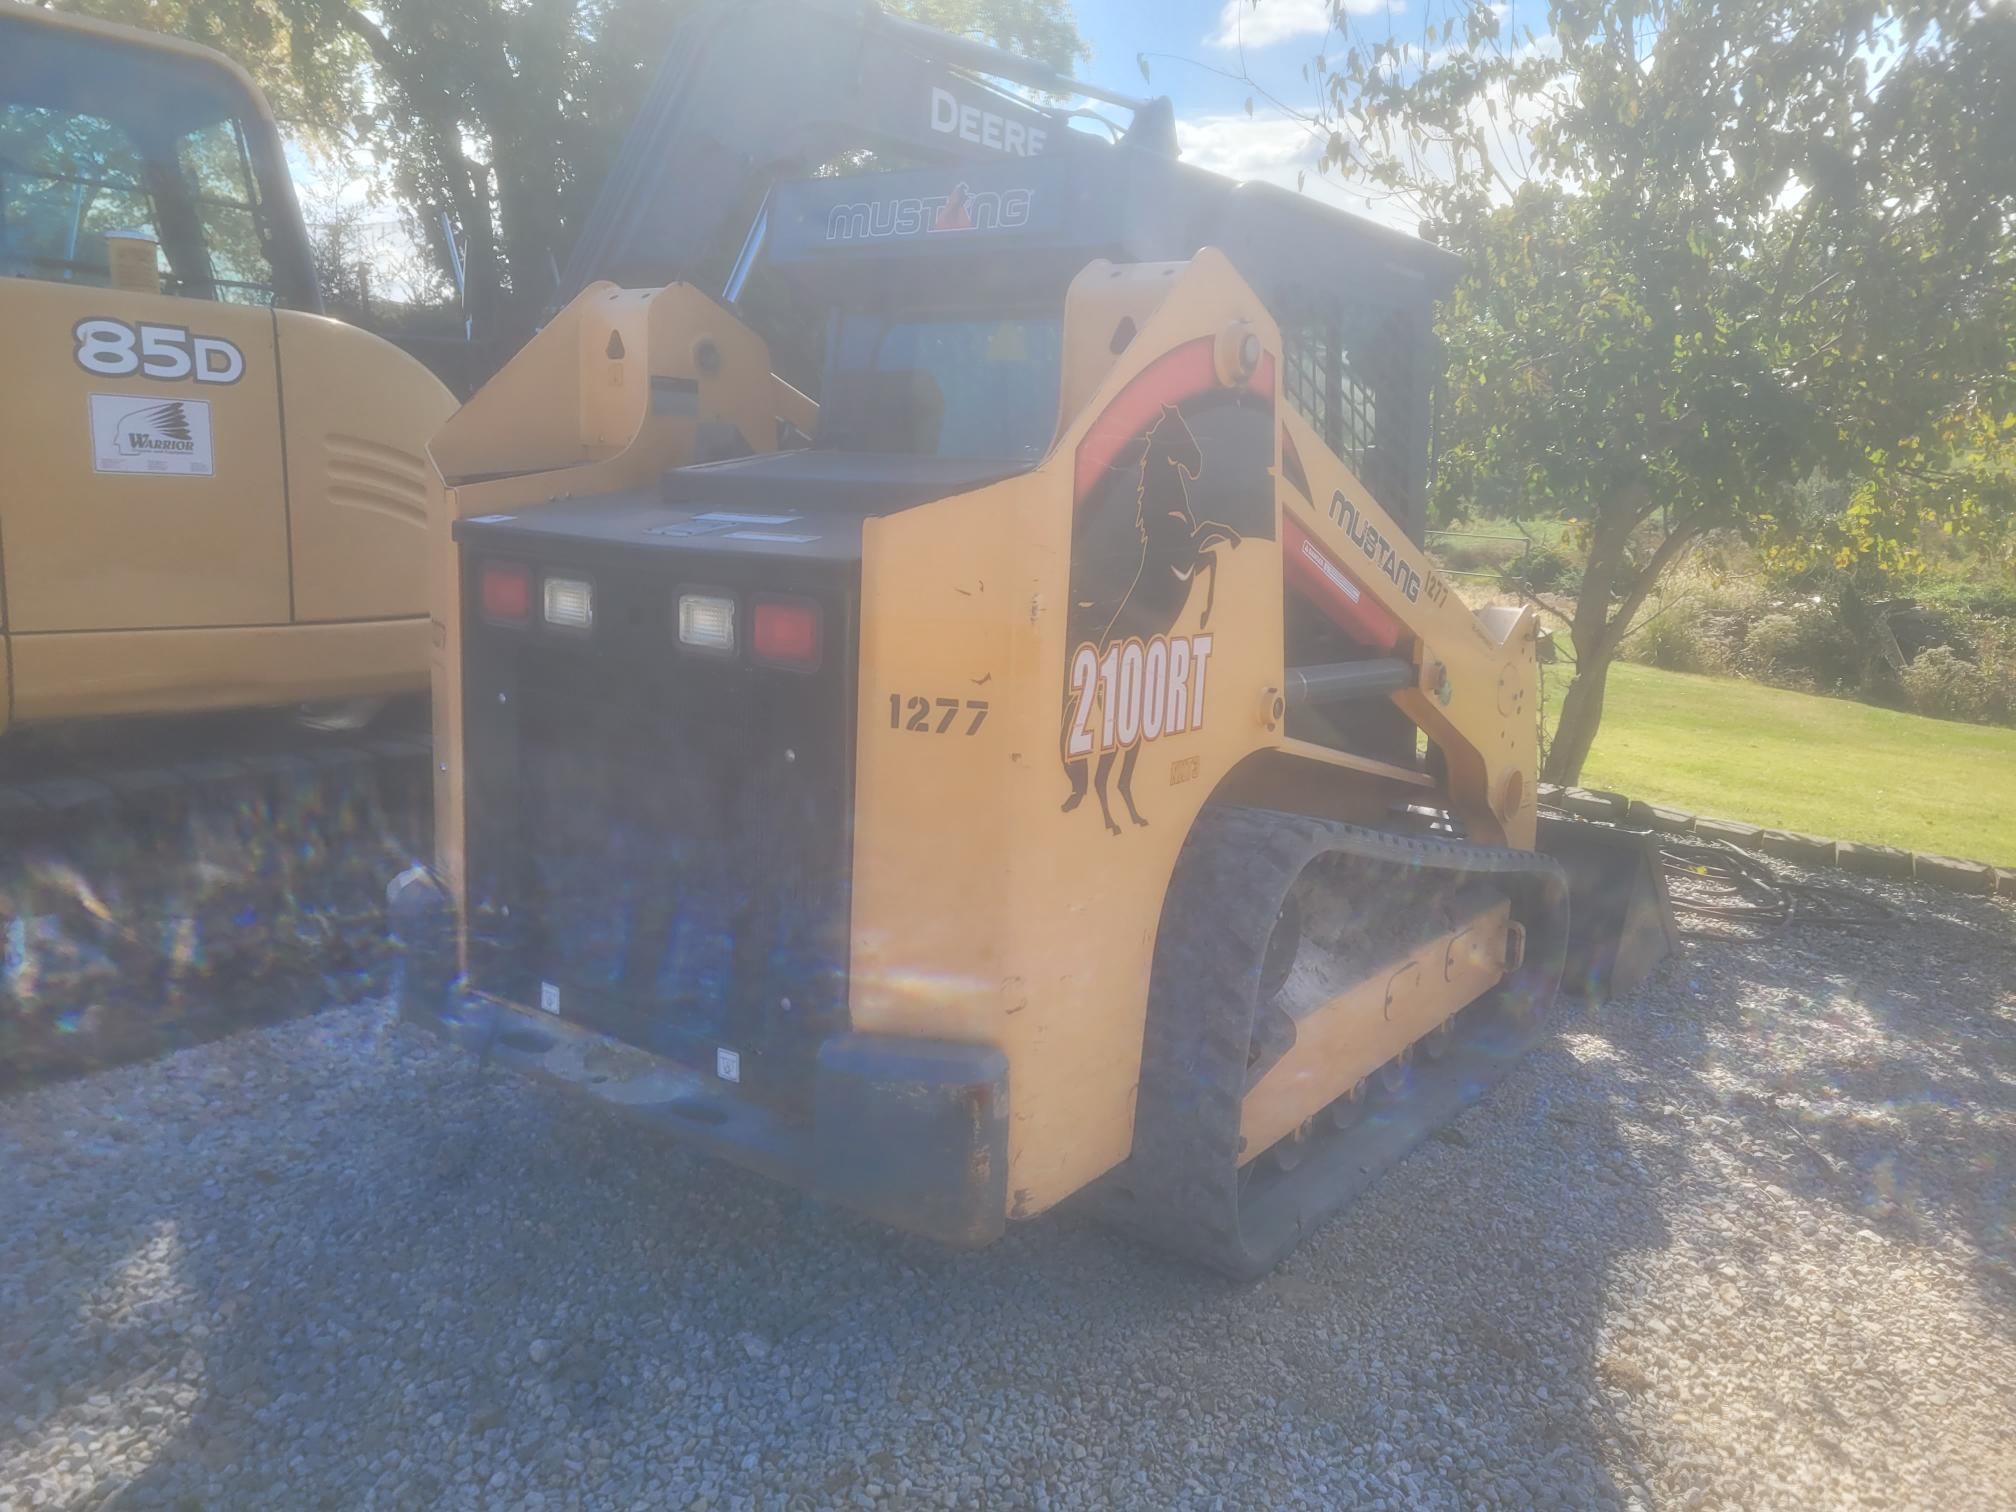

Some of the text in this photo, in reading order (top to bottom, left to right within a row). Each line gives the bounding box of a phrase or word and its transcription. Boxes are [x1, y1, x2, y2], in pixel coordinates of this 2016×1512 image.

[931, 86, 1047, 157] DEERE
[826, 183, 1031, 239] MUSTANG
[74, 318, 245, 383] 85D
[128, 432, 195, 451] WARRIOR
[1328, 488, 1421, 603] MUSTANG
[1423, 570, 1449, 608] 1277
[889, 693, 989, 736] 1277
[1066, 634, 1214, 760] 2100RT
